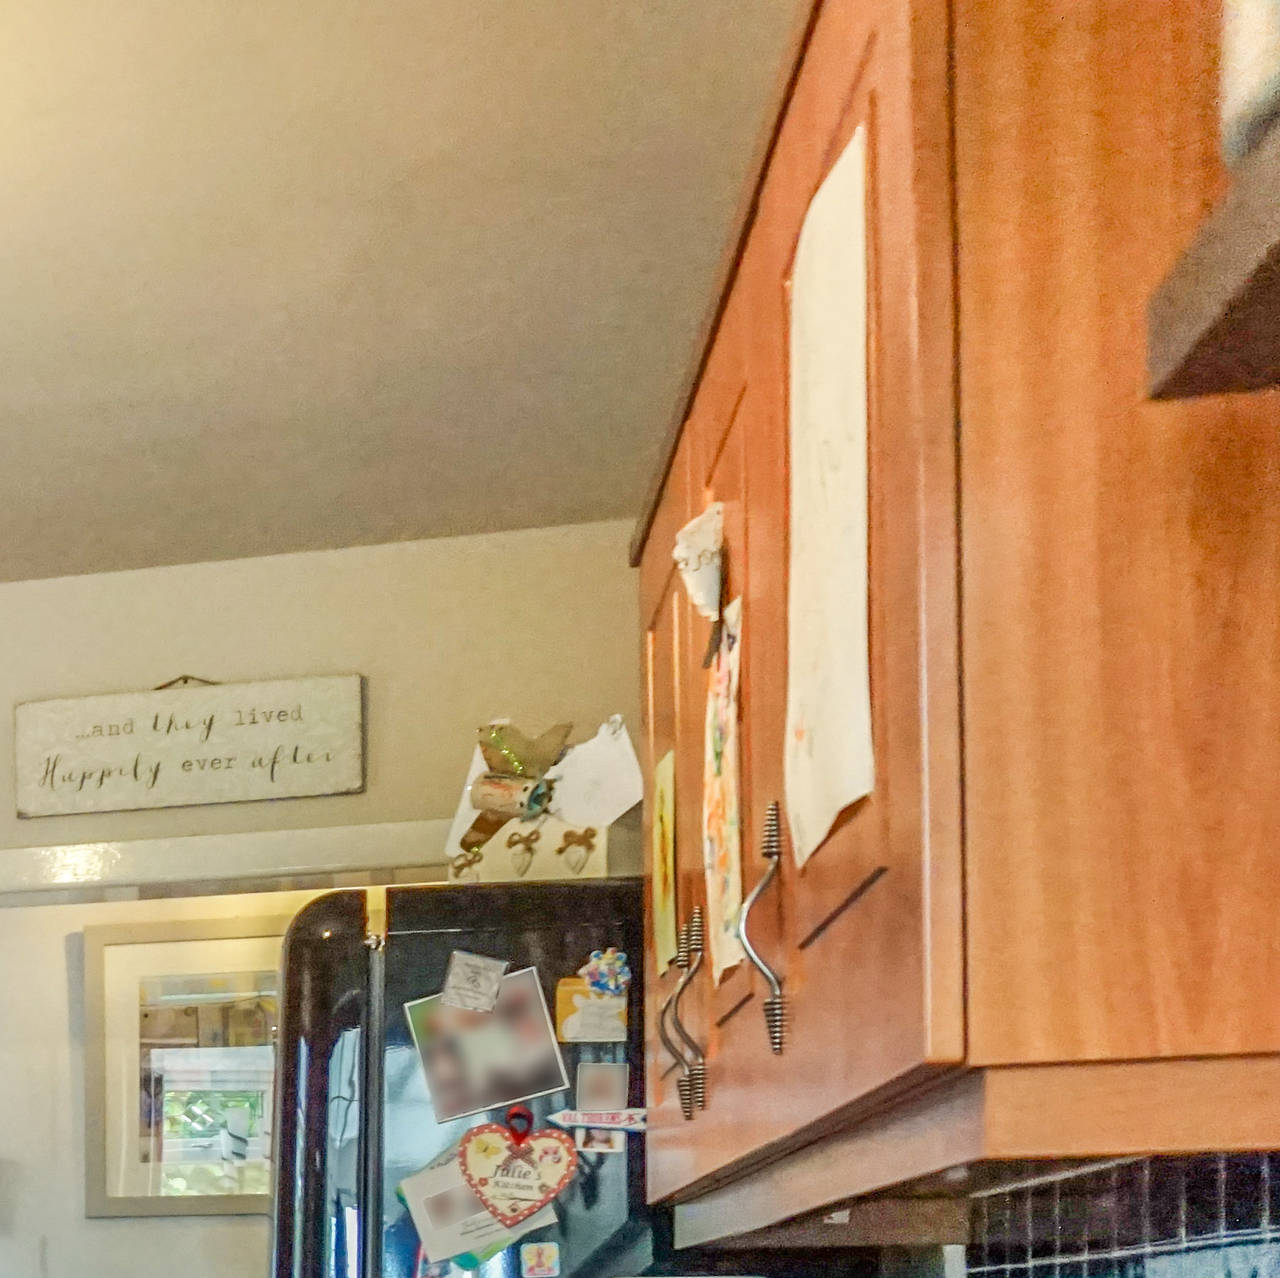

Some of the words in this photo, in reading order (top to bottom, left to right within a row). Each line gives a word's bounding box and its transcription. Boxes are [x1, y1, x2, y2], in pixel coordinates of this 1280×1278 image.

[152, 712, 216, 742] they
[234, 704, 304, 727] lived
[39, 751, 162, 792] Happily
[180, 755, 238, 773] ever
[251, 744, 336, 783] after
